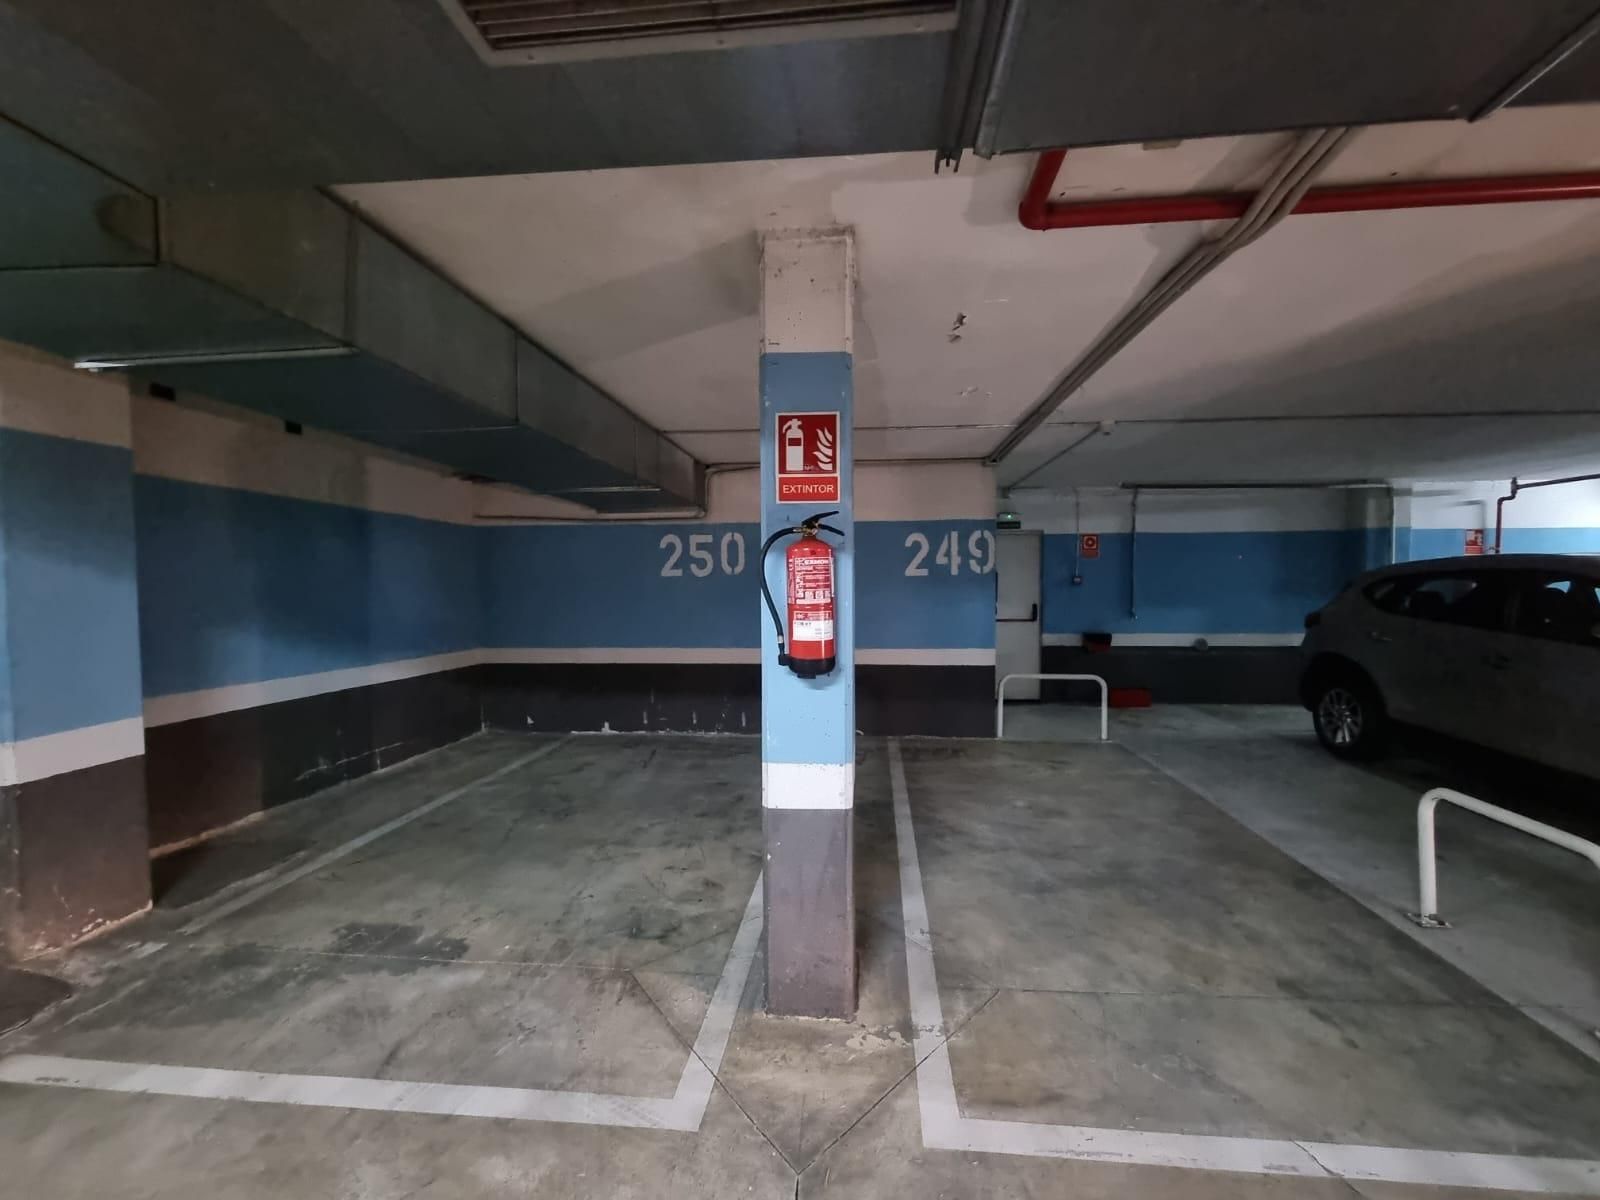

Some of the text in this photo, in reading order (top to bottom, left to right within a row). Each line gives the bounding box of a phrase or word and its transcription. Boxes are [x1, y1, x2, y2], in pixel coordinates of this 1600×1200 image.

[783, 484, 834, 494] EXTINTOR
[659, 532, 745, 578] 250
[904, 530, 996, 578] 249
